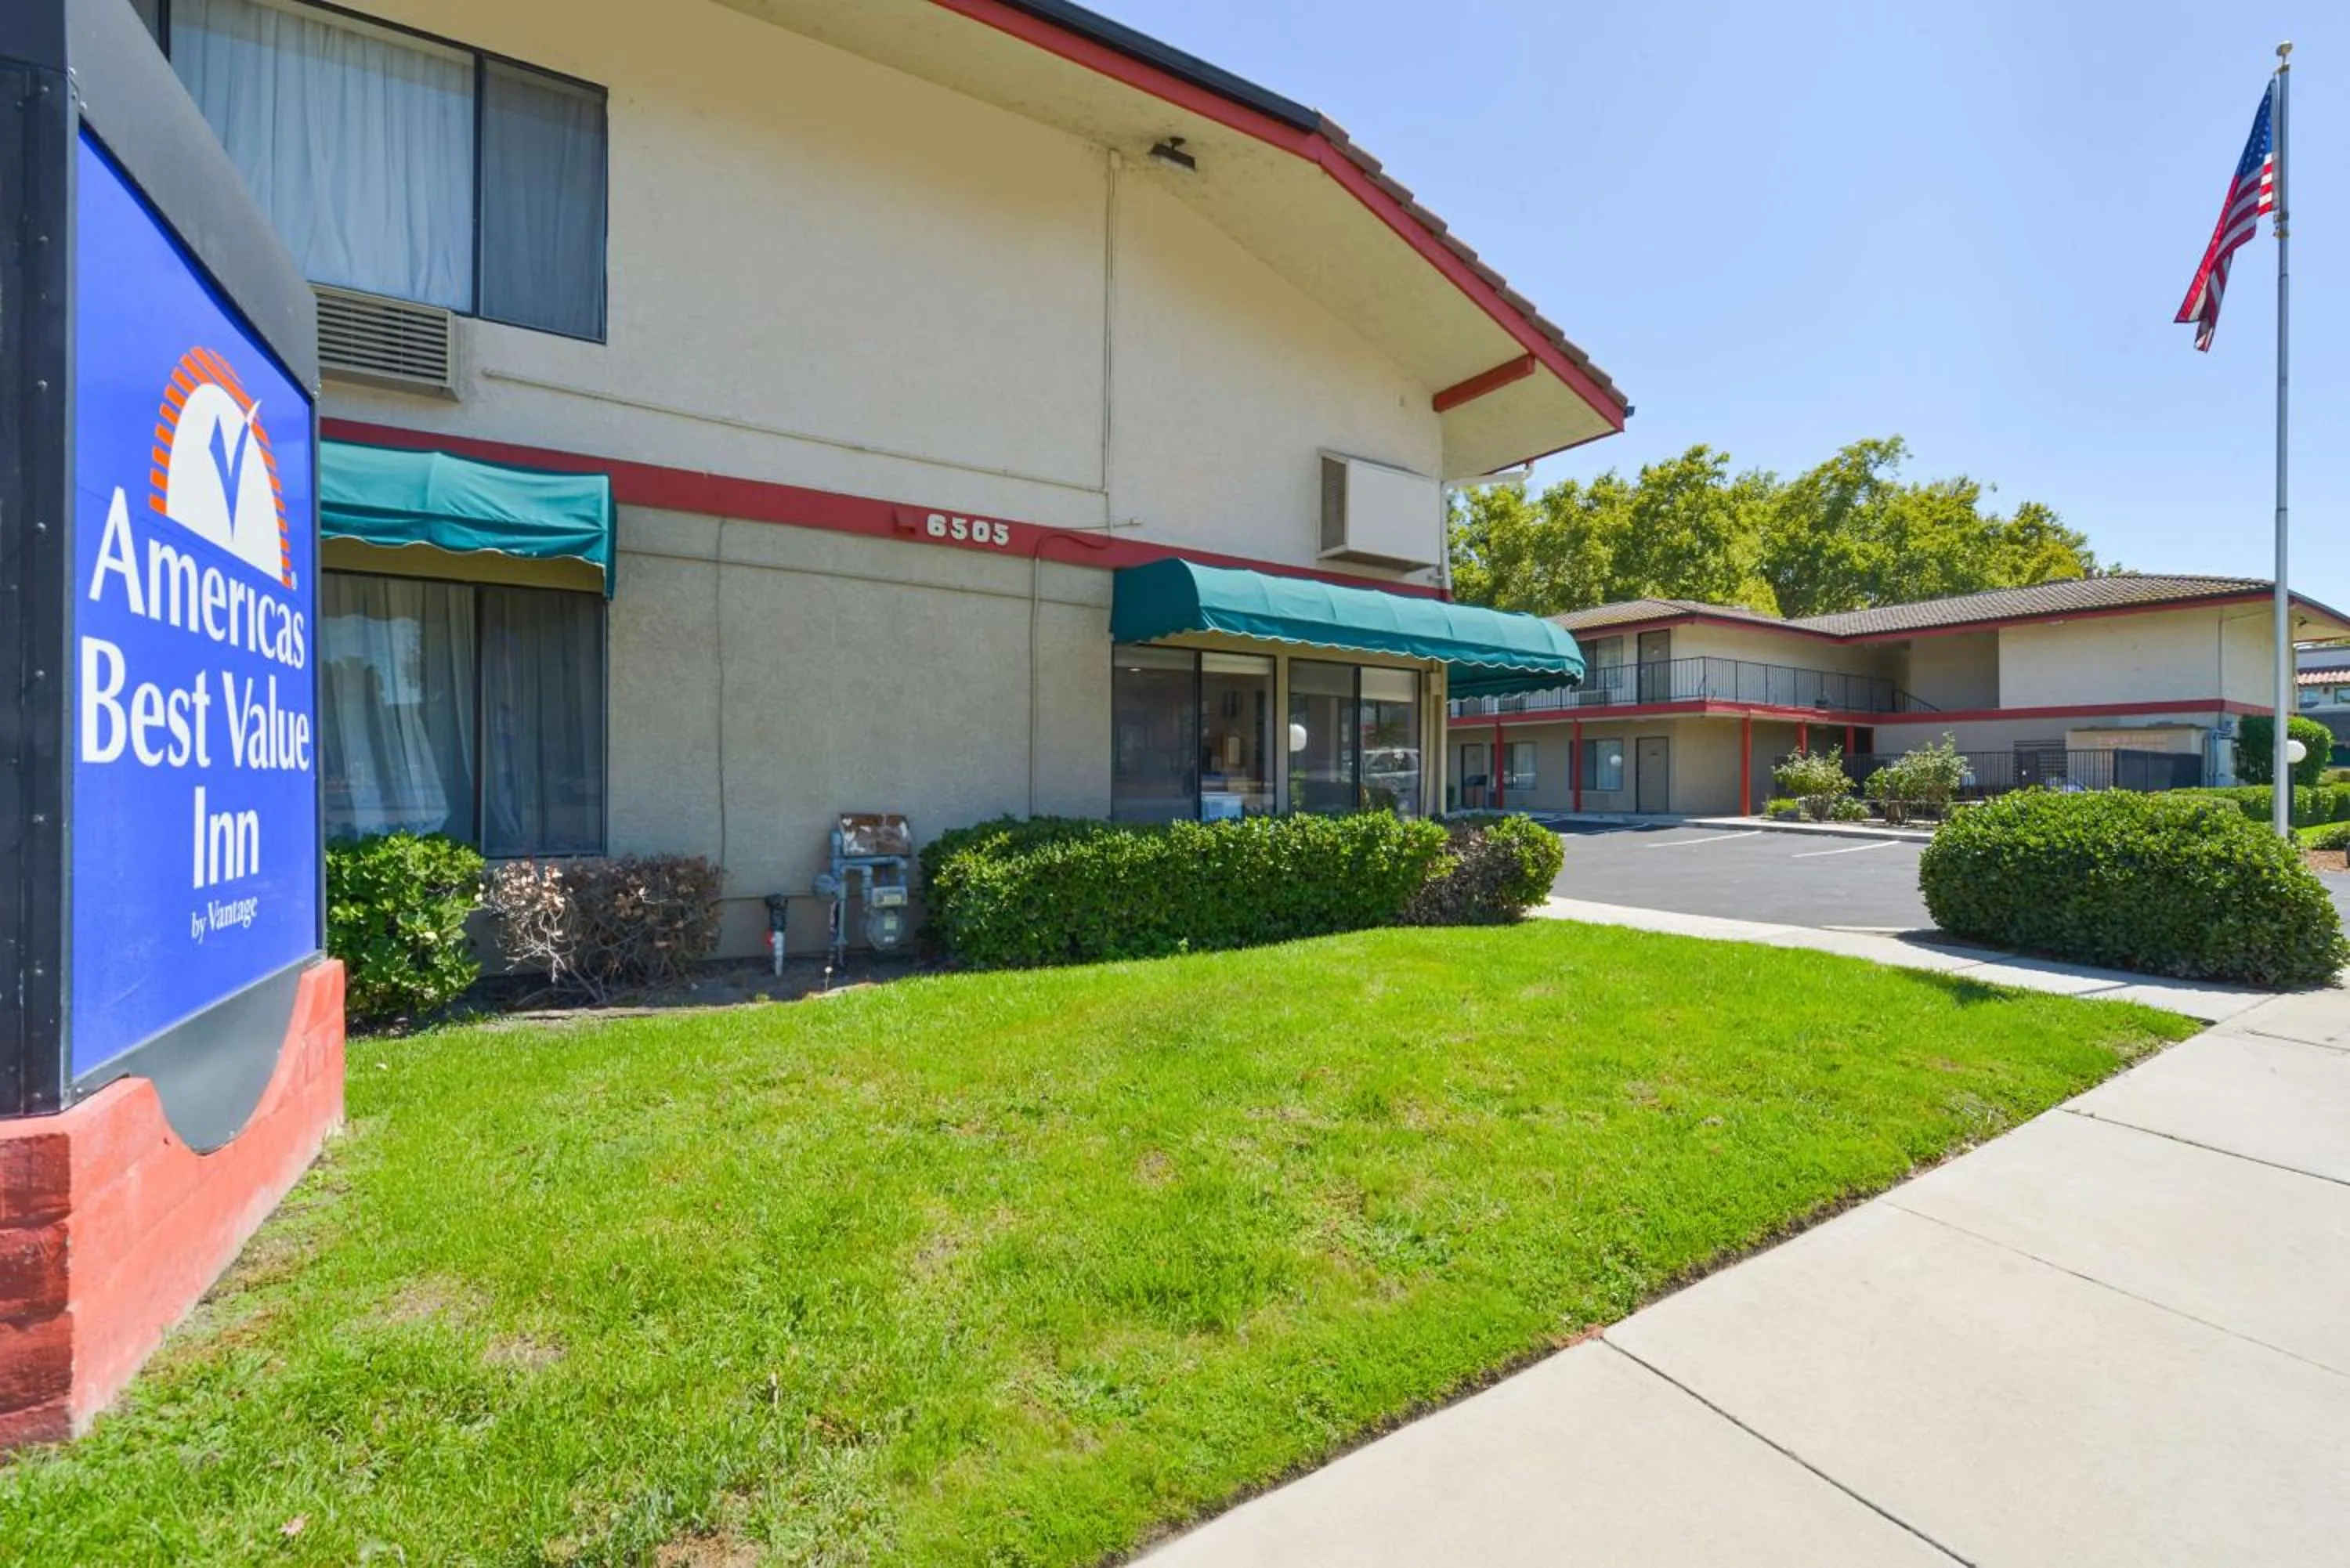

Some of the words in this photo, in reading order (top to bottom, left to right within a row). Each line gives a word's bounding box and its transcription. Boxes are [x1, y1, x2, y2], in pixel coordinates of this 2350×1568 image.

[88, 485, 306, 669] Americas
[927, 513, 1010, 546] 6505
[81, 635, 212, 768] Best
[222, 670, 310, 771] Value
[193, 785, 259, 890] Inn
[190, 910, 207, 945] by
[207, 895, 258, 932] Vantage
